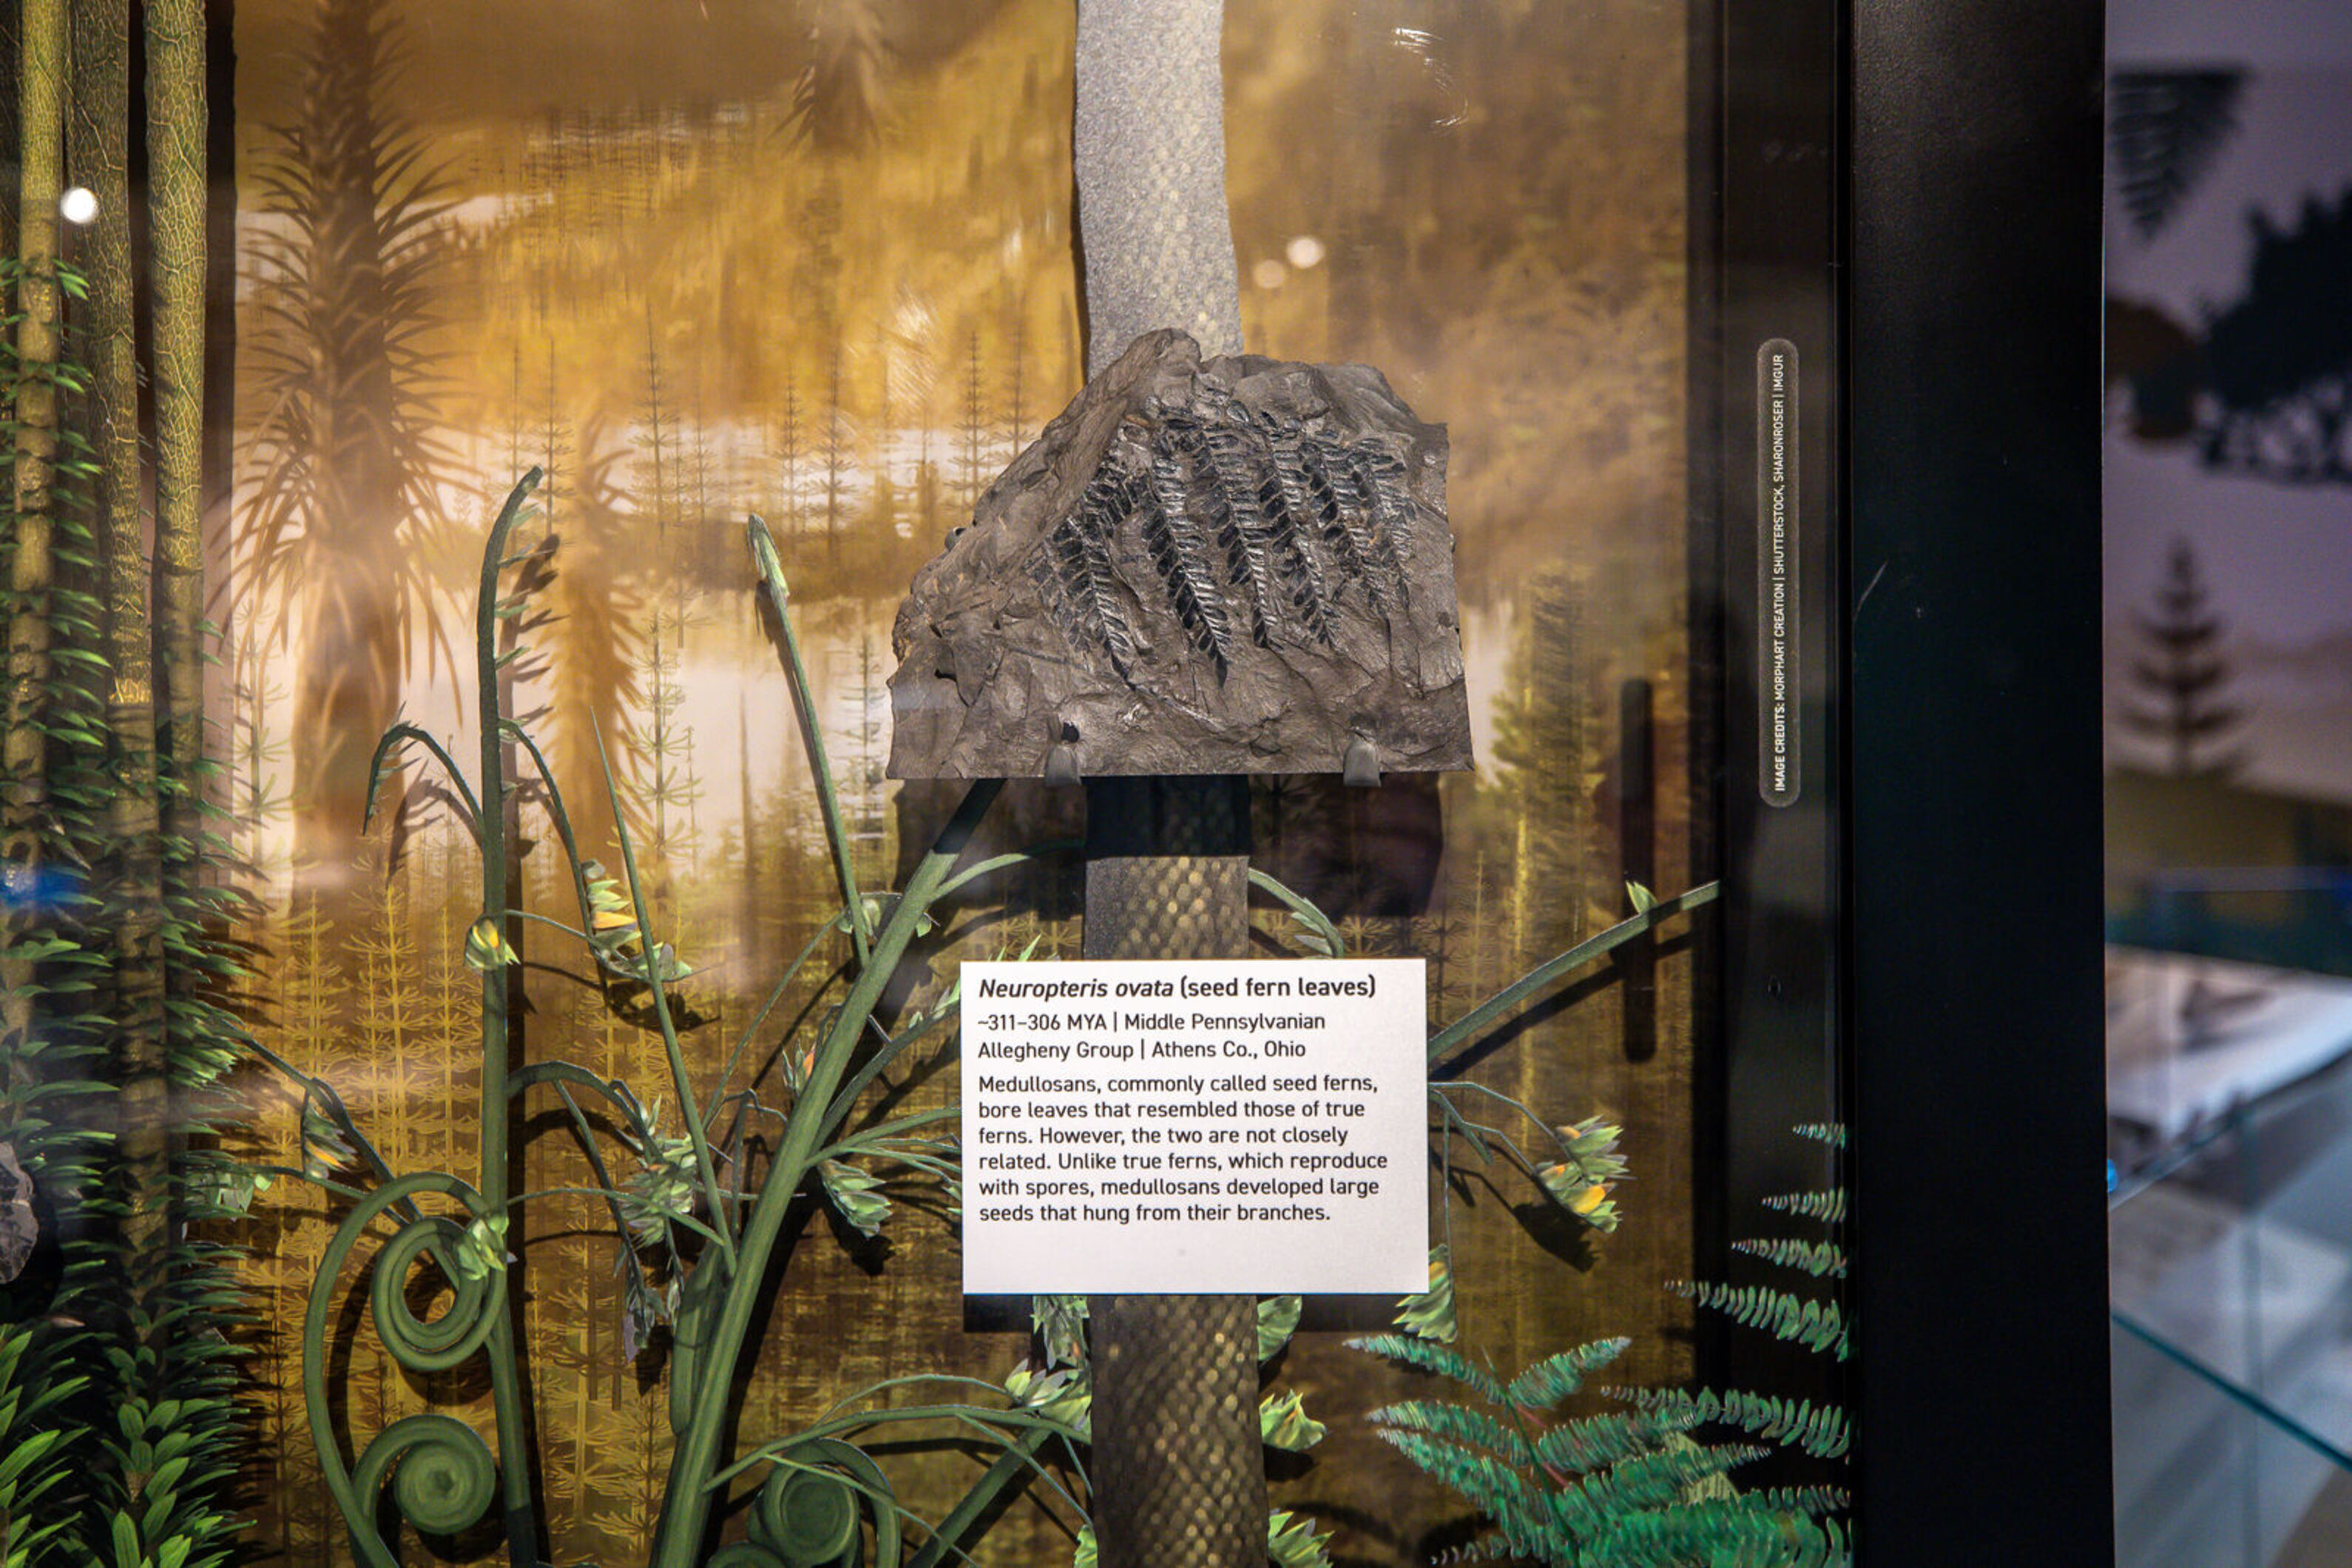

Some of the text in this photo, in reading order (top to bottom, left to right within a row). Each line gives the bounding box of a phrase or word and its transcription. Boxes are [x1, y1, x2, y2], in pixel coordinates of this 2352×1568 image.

[1772, 354, 1784, 391] IMGUR
[1773, 484, 1787, 575] SHUTTERSTOCK,
[1773, 583, 1785, 638] CREATION
[1773, 639, 1785, 701] MORPHART
[1774, 703, 1785, 754] CREDITS:
[1774, 755, 1785, 791] IMAGE
[979, 974, 1376, 1002] Neuropteris ovata (seed fern leaves)
[1067, 1013, 1107, 1030] MYA
[1125, 1013, 1185, 1030] Middle
[1192, 1013, 1325, 1033] Pennsylvanian
[978, 1041, 1070, 1063] Allegheny
[1076, 1041, 1134, 1062] Group
[1152, 1041, 1217, 1058] Athens
[1223, 1040, 1258, 1060] Co.,
[1264, 1040, 1306, 1057] Ohio
[979, 1074, 1378, 1095] Medullosans, commonly called seed ferns,
[979, 1100, 1365, 1118] bore leaves that resembled those of true
[979, 1126, 1348, 1147] ferns. However, the two are not closely
[979, 1152, 1388, 1173] related. Unlike true ferns, which reproduce
[979, 1177, 1379, 1199] with spores, medullosans developed large
[979, 1203, 1331, 1225] seeds that hung from their branches.
